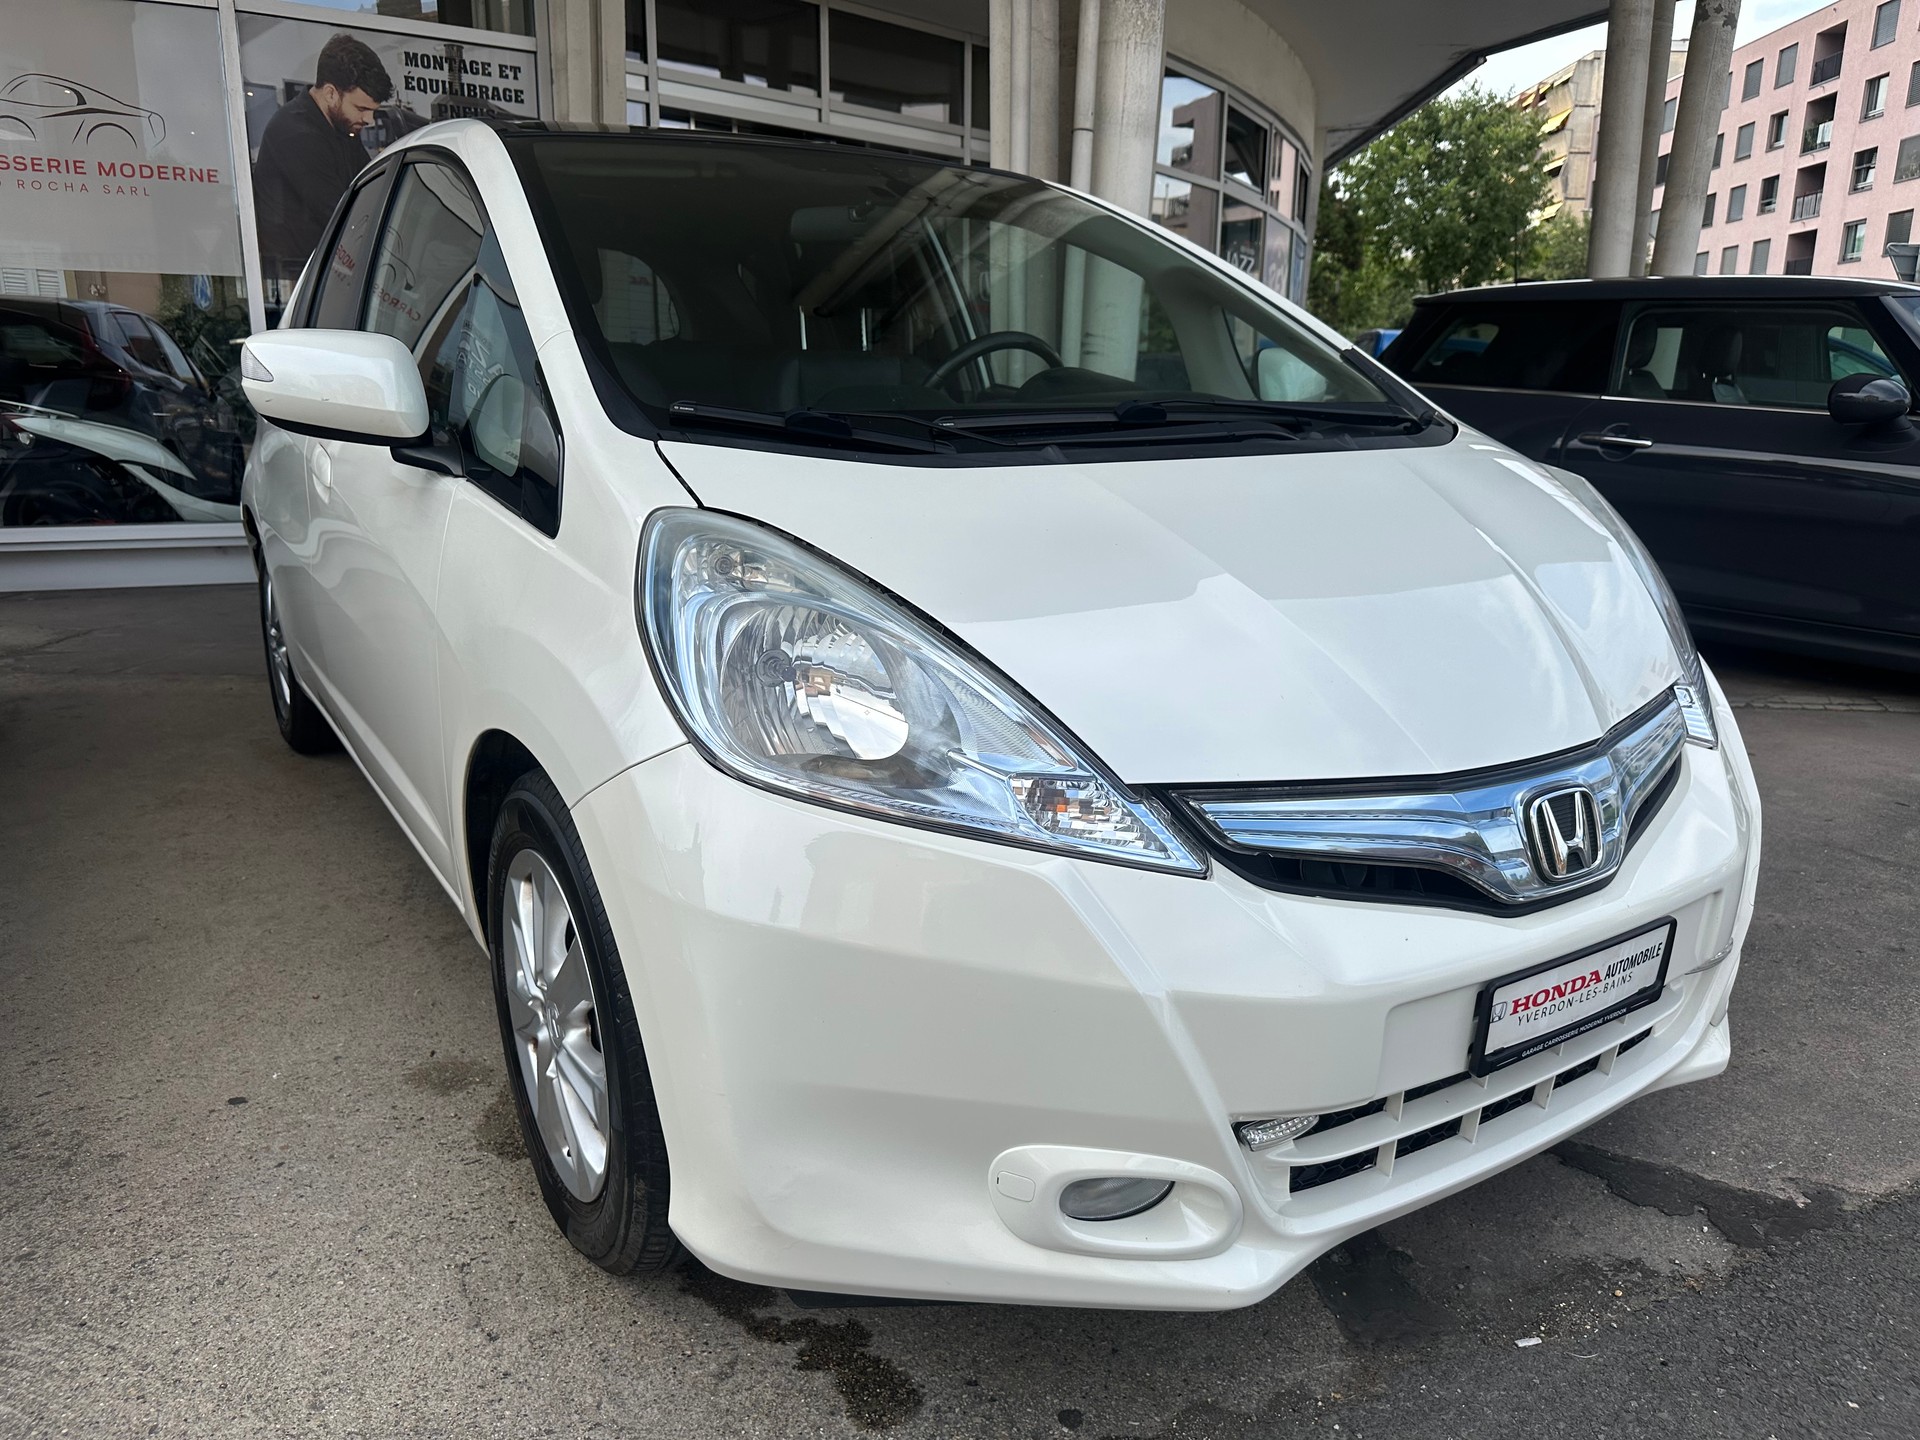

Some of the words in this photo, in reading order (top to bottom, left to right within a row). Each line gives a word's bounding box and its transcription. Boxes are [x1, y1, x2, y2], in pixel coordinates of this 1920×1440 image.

[403, 51, 492, 78] MONTAGE
[498, 63, 522, 81] ET
[403, 71, 525, 104] ÉQUILIBRAGE
[0, 154, 87, 175] SSERIE
[97, 161, 220, 184] MODERNE
[16, 178, 89, 193] ROCHA
[103, 184, 151, 197] SARL
[1509, 969, 1603, 1016] HONDA
[1603, 942, 1663, 981] AUTOMOBILE
[1517, 971, 1634, 1026] YVERDON-LES-BAINS
[1521, 1043, 1544, 1058] GARAGE
